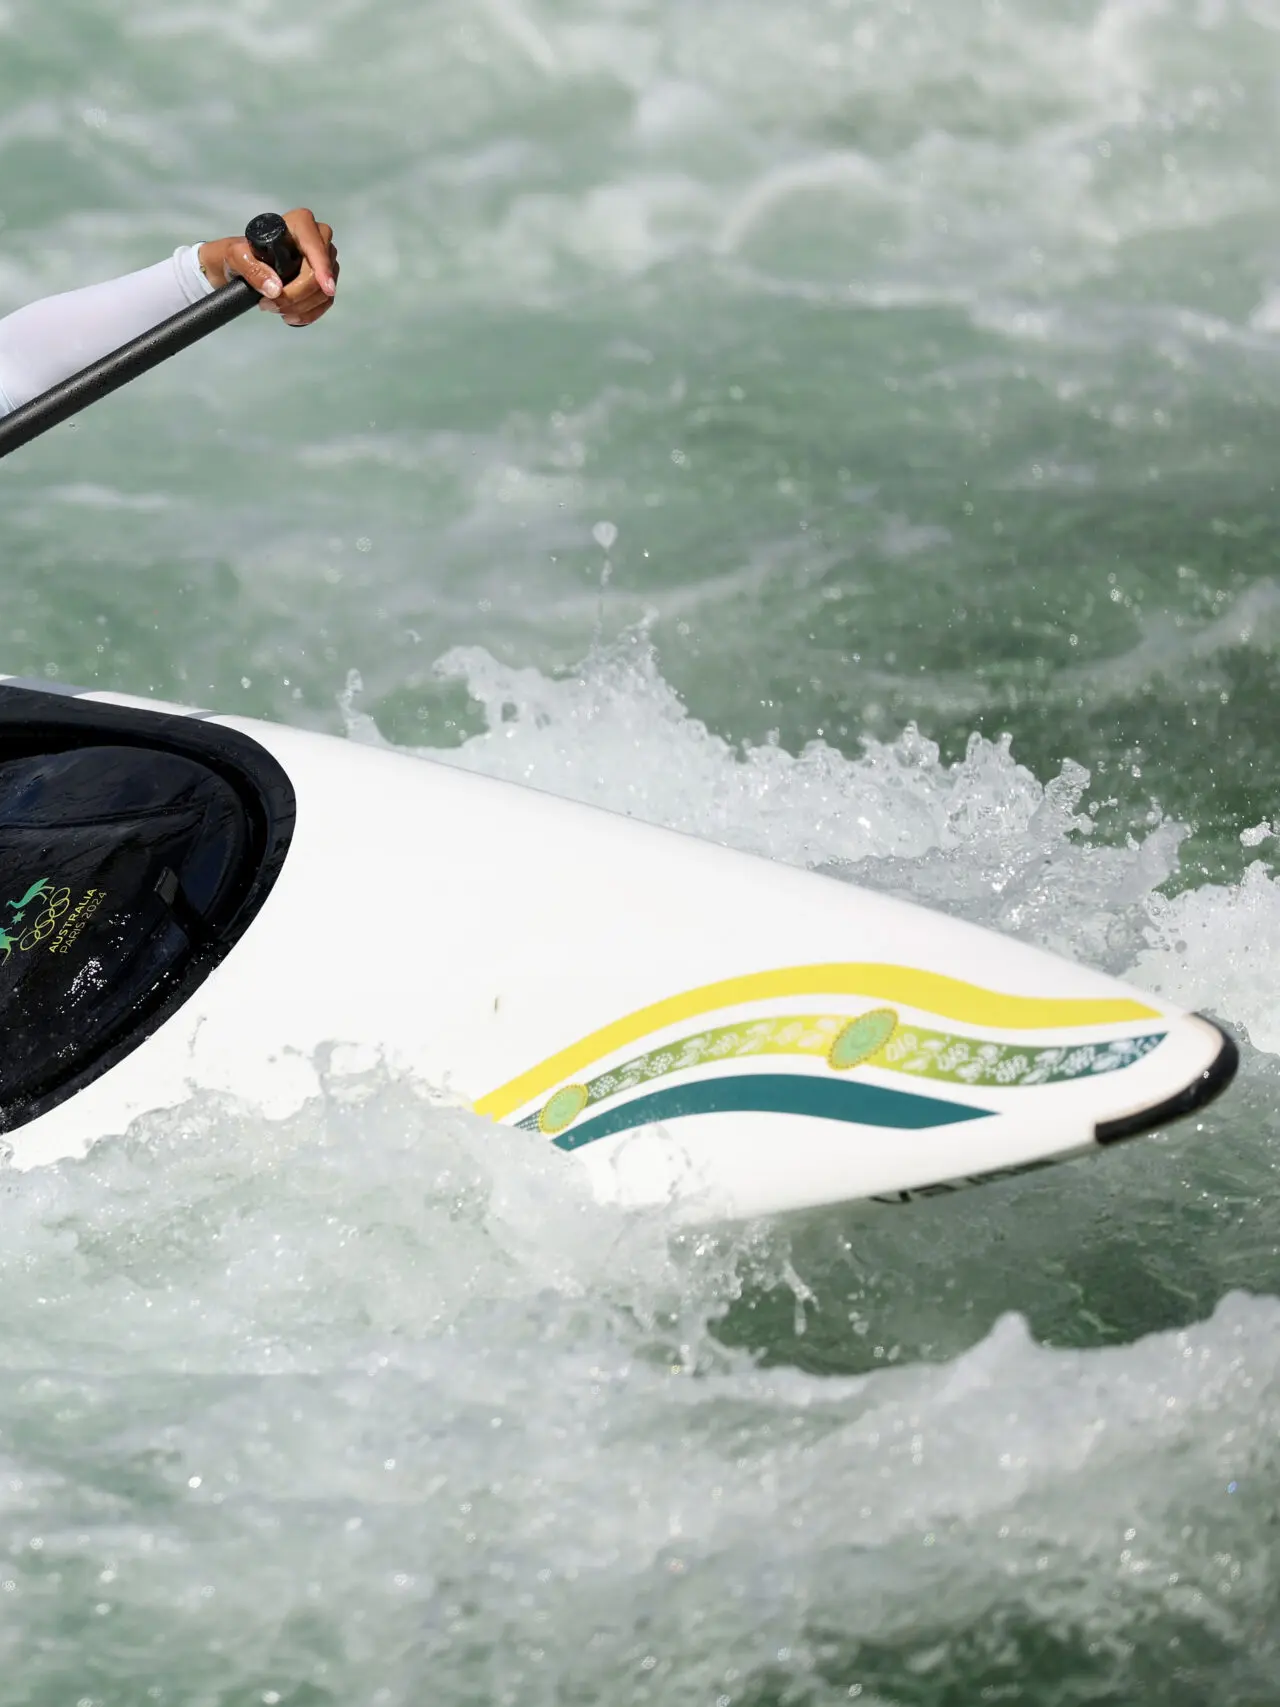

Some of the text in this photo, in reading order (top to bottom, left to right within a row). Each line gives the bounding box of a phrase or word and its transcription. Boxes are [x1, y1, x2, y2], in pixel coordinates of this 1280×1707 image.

[48, 888, 98, 953] AUSTRALIA
[59, 891, 108, 954] PARIS 2024
